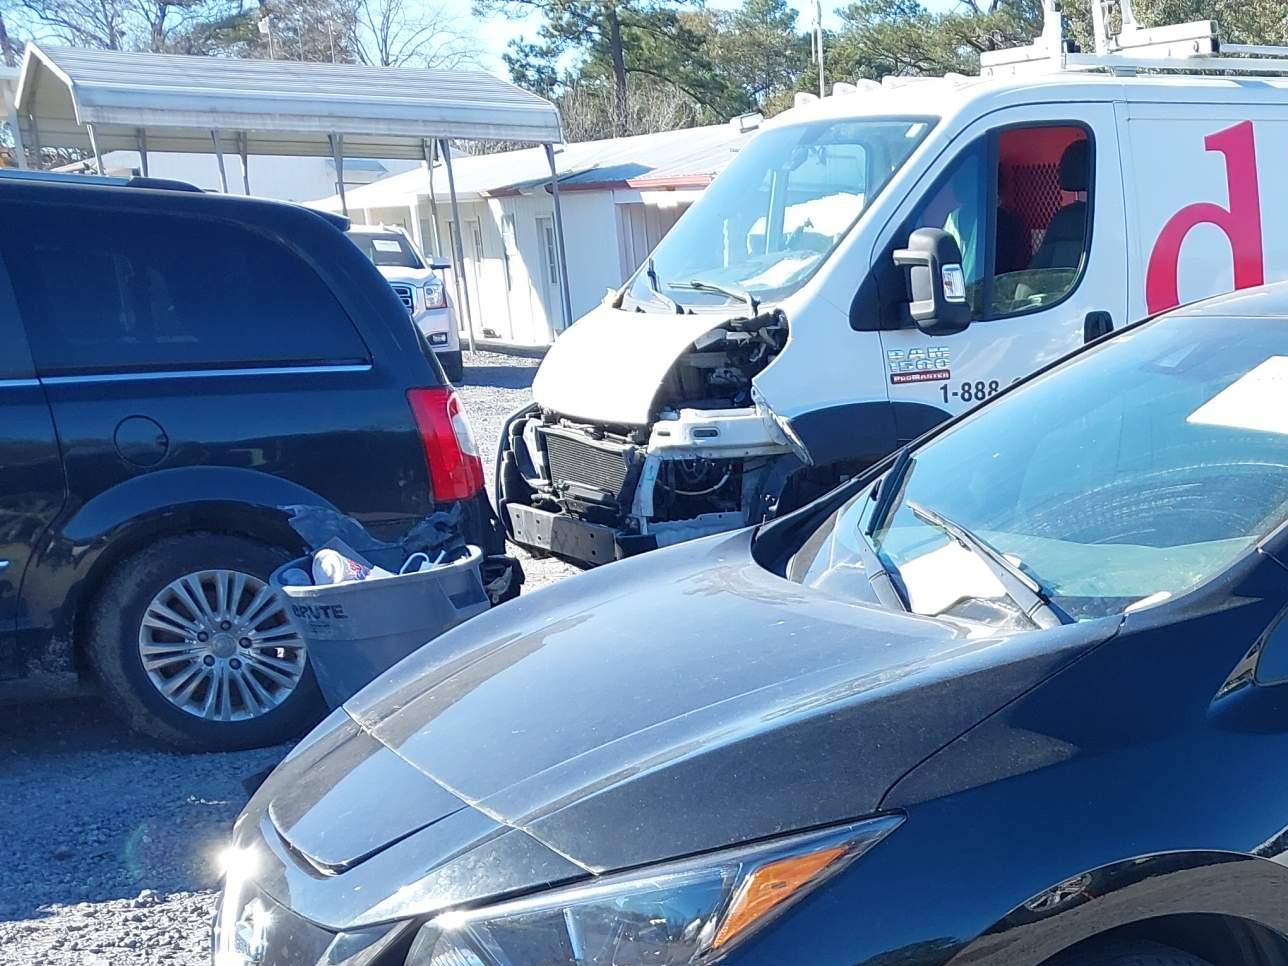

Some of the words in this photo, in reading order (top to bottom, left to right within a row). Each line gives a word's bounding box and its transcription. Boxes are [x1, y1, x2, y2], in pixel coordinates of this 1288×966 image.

[887, 347, 950, 360] RAM
[889, 357, 951, 372] 1500
[291, 603, 348, 619] BRUTE
